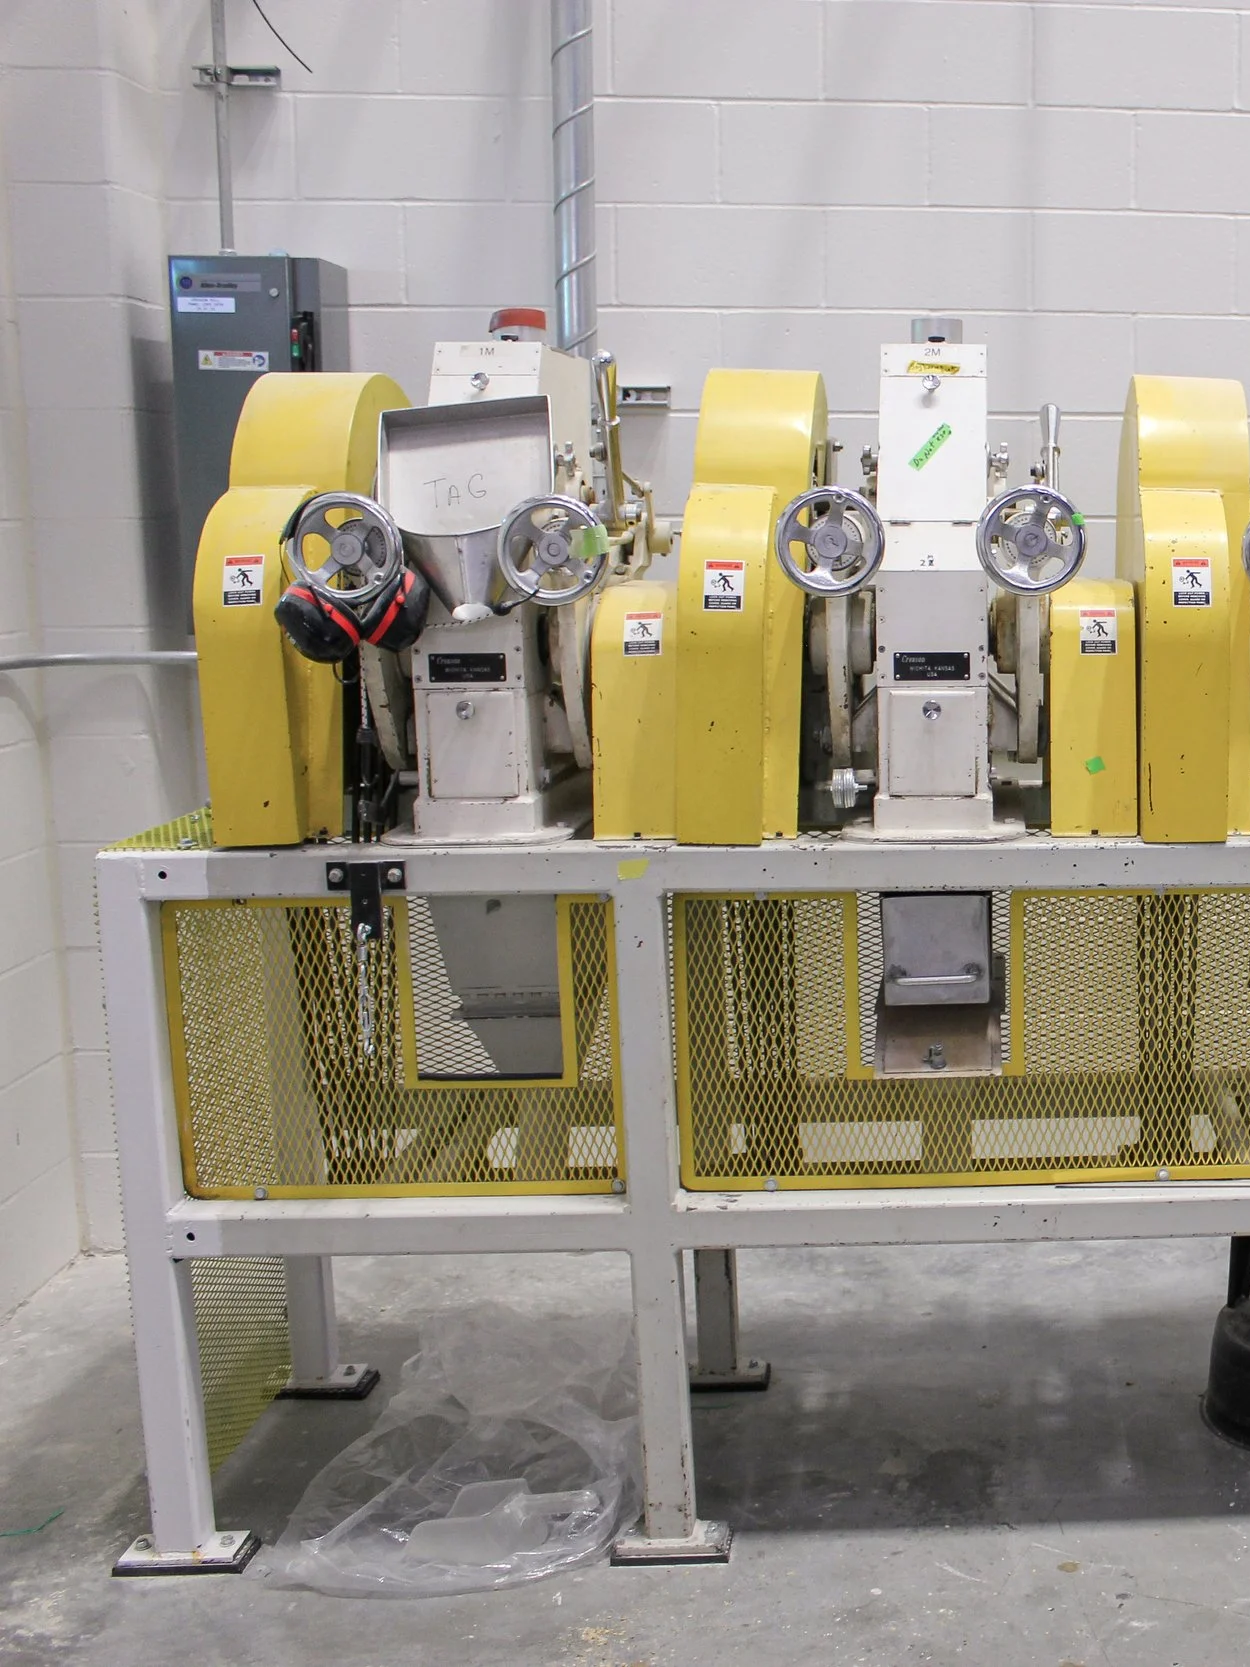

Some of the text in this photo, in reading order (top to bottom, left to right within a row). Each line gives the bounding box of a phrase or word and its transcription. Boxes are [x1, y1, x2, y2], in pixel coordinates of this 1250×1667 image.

[479, 347, 495, 356] 1M
[924, 347, 941, 357] 2M
[423, 473, 487, 509] TAG
